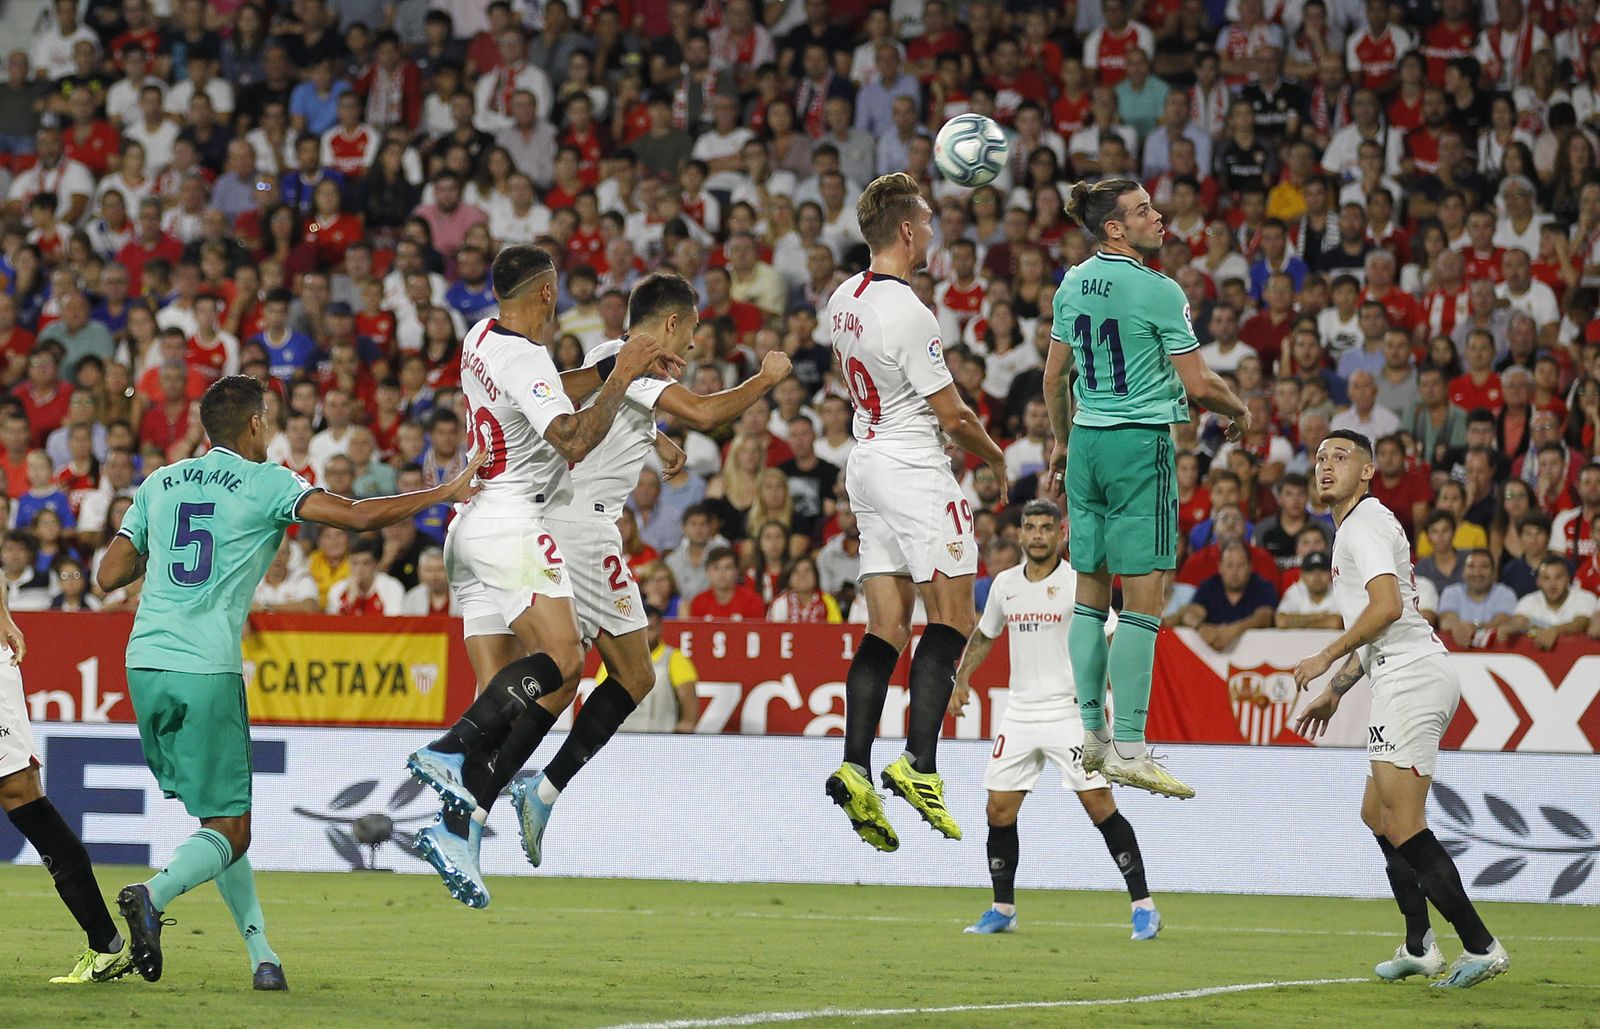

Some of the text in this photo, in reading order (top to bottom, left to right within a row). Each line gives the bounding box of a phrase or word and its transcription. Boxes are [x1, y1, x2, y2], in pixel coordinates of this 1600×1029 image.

[1081, 278, 1113, 299] BALE
[1072, 314, 1129, 396] 11
[837, 349, 881, 440] 9
[162, 467, 243, 493] R.VAANE
[944, 498, 974, 537] 19
[167, 501, 216, 588] 5
[602, 554, 641, 593] 2
[1006, 612, 1063, 623] ARATHON
[1018, 622, 1040, 633] BET
[678, 630, 795, 660] ESDE
[29, 655, 125, 722] nk
[258, 660, 409, 697] CARTAYA
[1368, 740, 1397, 754] verfx
